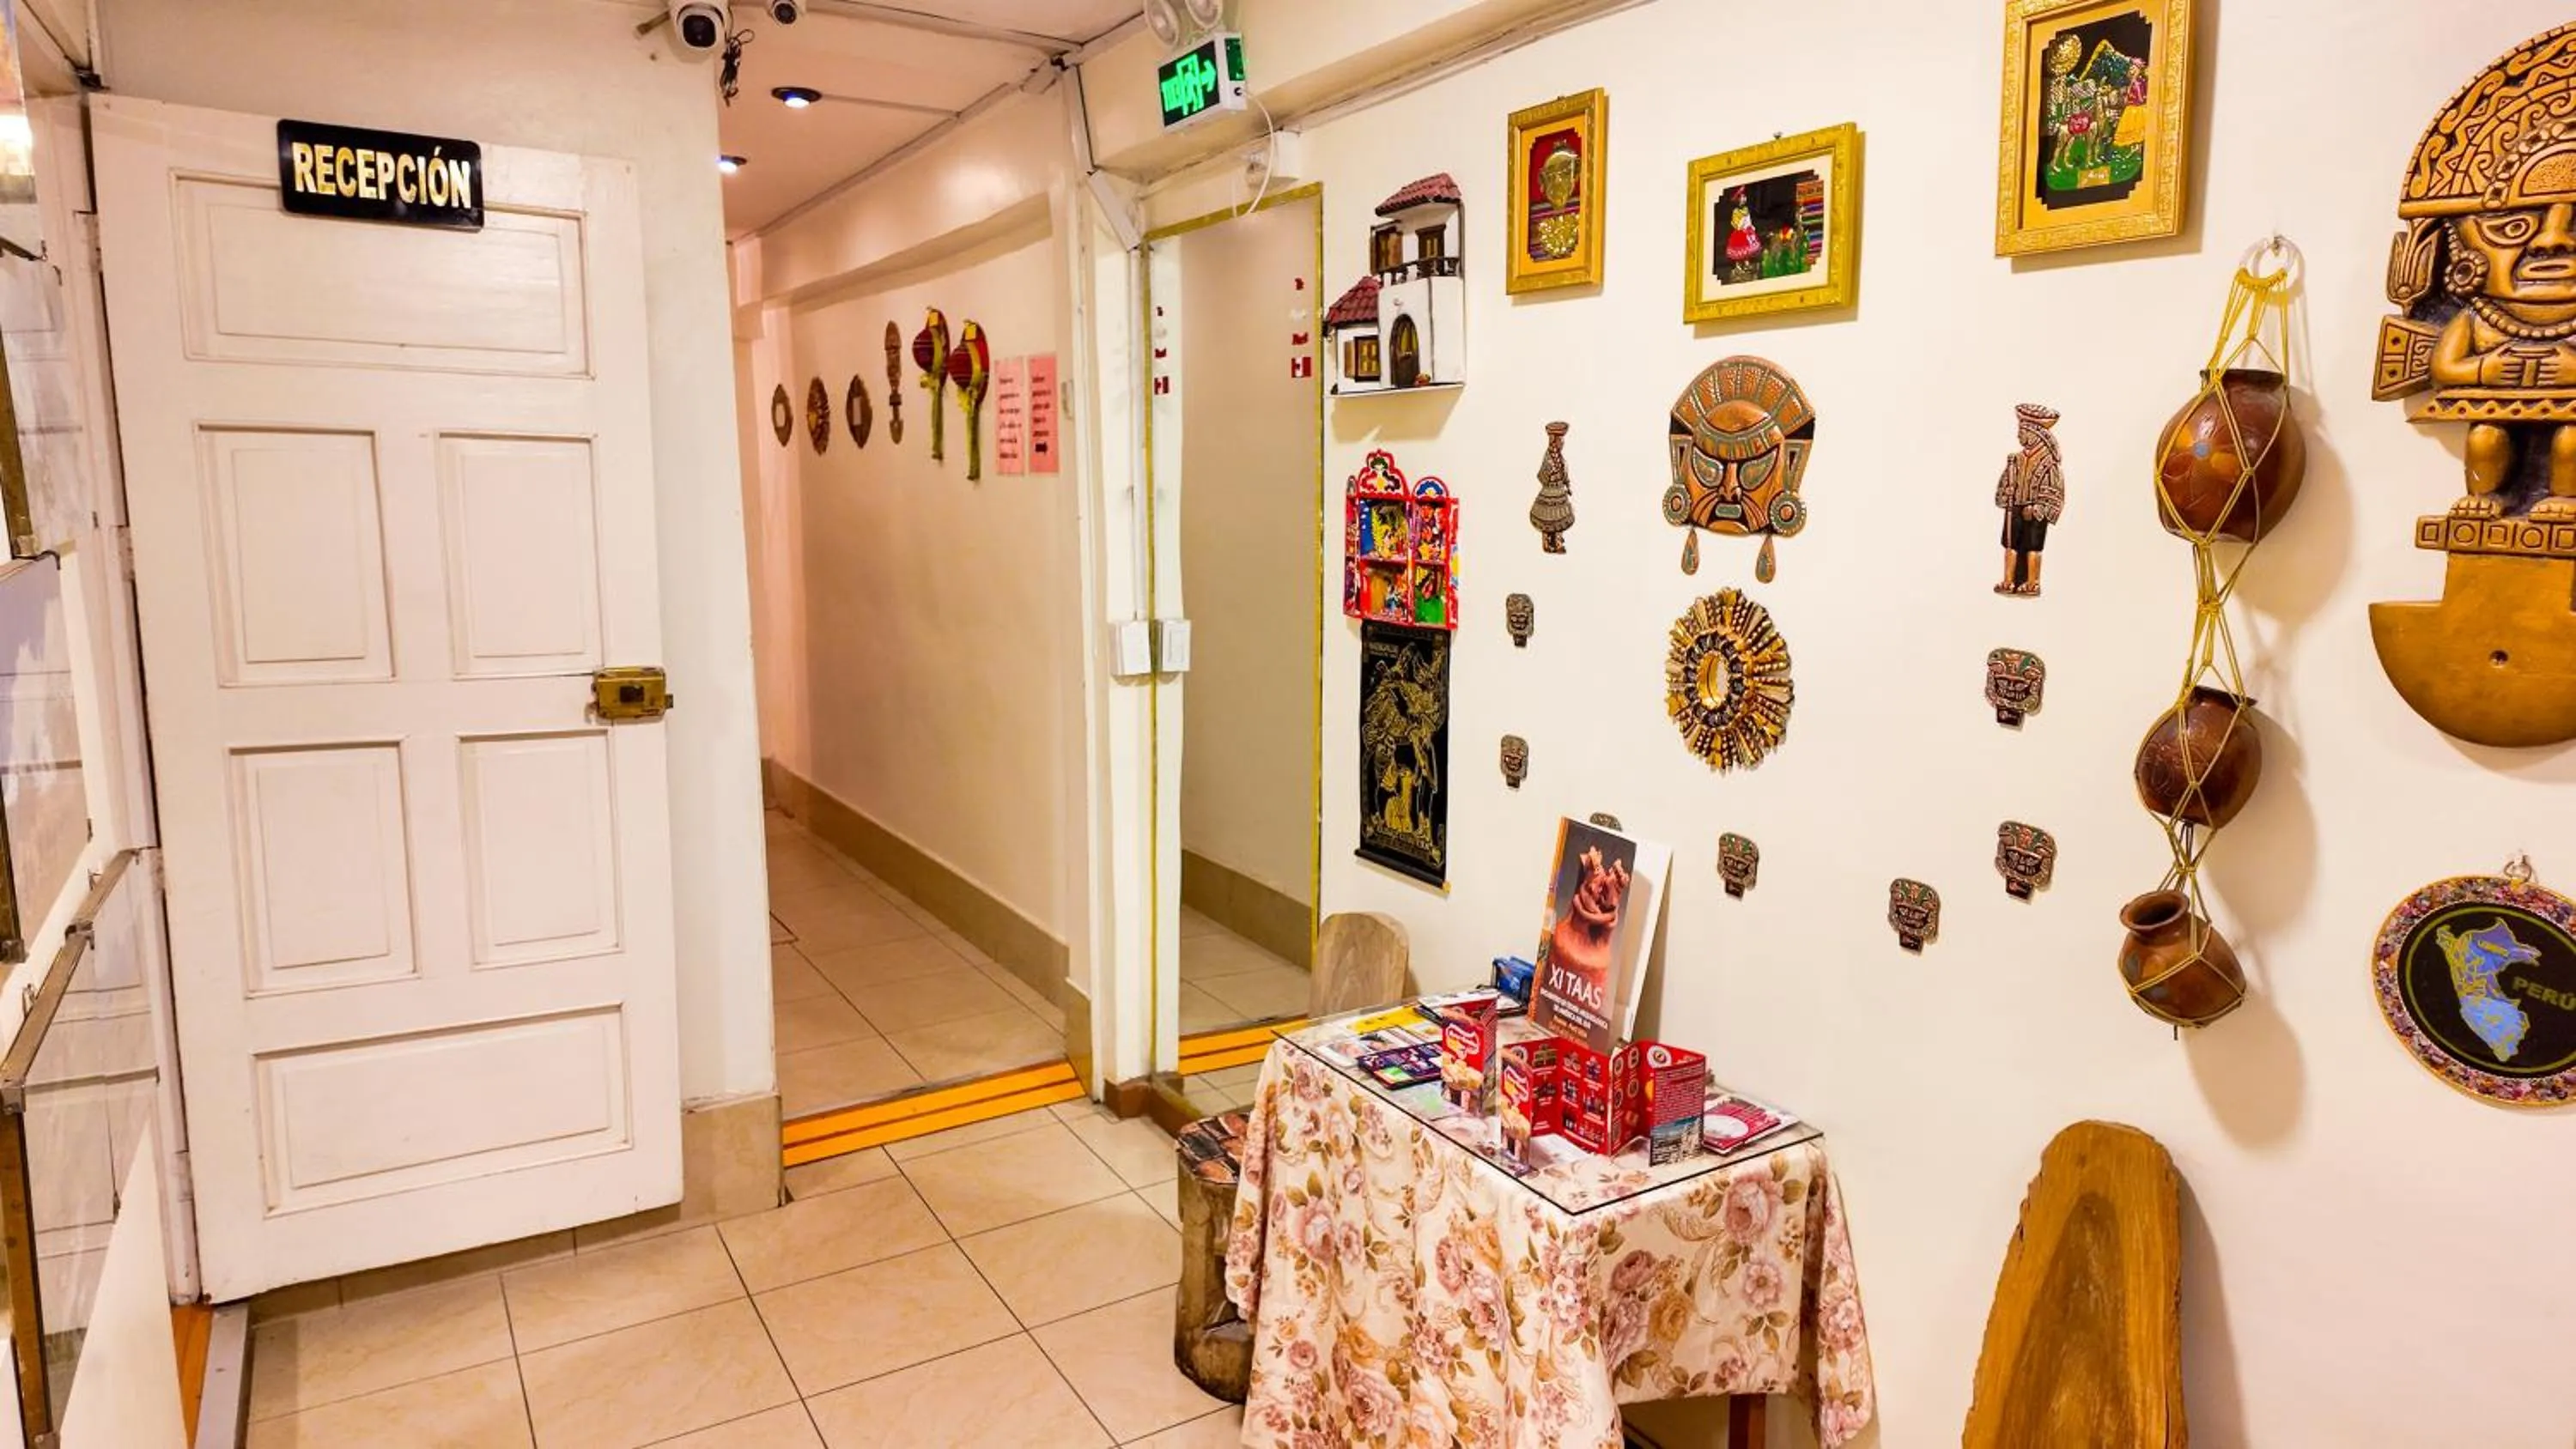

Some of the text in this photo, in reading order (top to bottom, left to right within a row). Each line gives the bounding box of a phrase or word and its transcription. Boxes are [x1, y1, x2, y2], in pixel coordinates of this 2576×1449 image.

[292, 142, 472, 209] RECEPCIÓN
[1548, 963, 1564, 990] XI
[1565, 971, 1602, 1010] TAAS
[2512, 976, 2576, 1011] PERÚ
